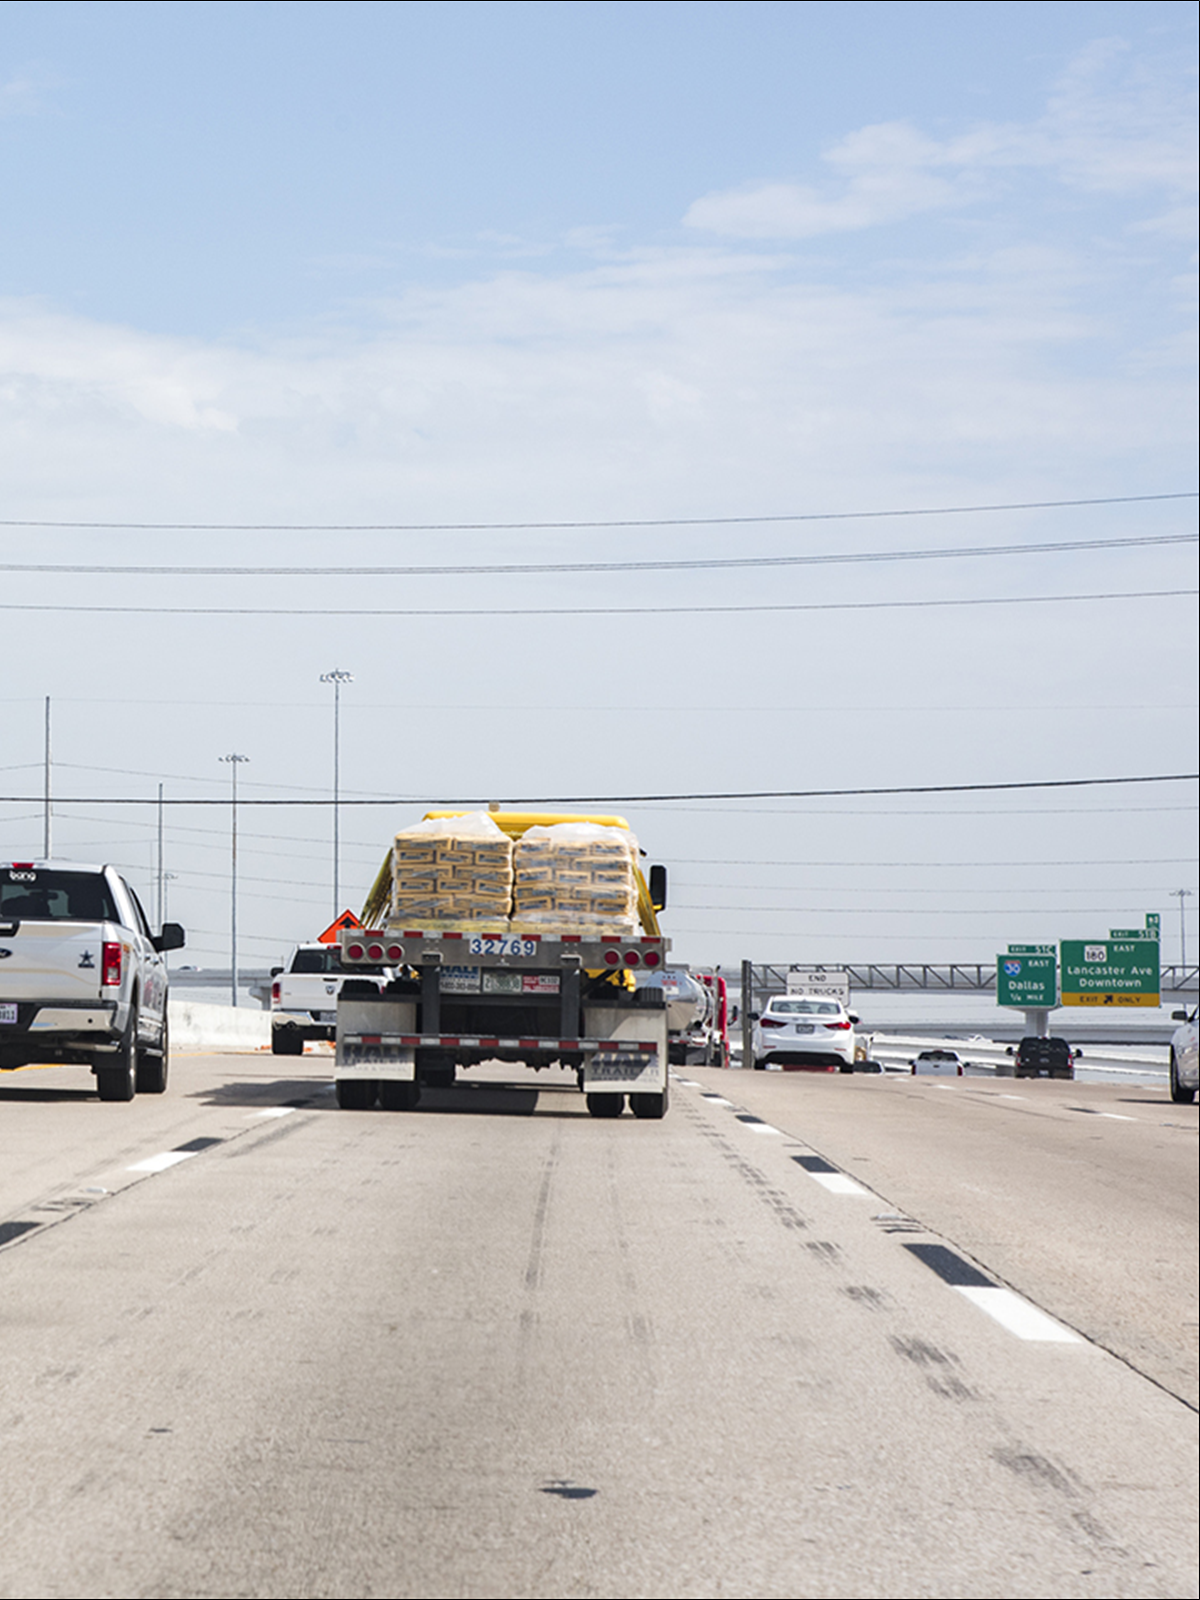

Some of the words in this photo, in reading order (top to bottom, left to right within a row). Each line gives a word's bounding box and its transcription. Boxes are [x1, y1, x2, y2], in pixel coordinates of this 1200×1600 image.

[471, 939, 535, 955] 32769
[1086, 950, 1105, 961] 180
[1067, 966, 1126, 976] Lancaster
[1130, 966, 1153, 976] Ave
[1008, 980, 1045, 990] Dallas
[1079, 978, 1142, 988] Downtown
[790, 987, 804, 995] NO
[1079, 995, 1098, 1003] EXIT
[1117, 995, 1141, 1003] ONLY
